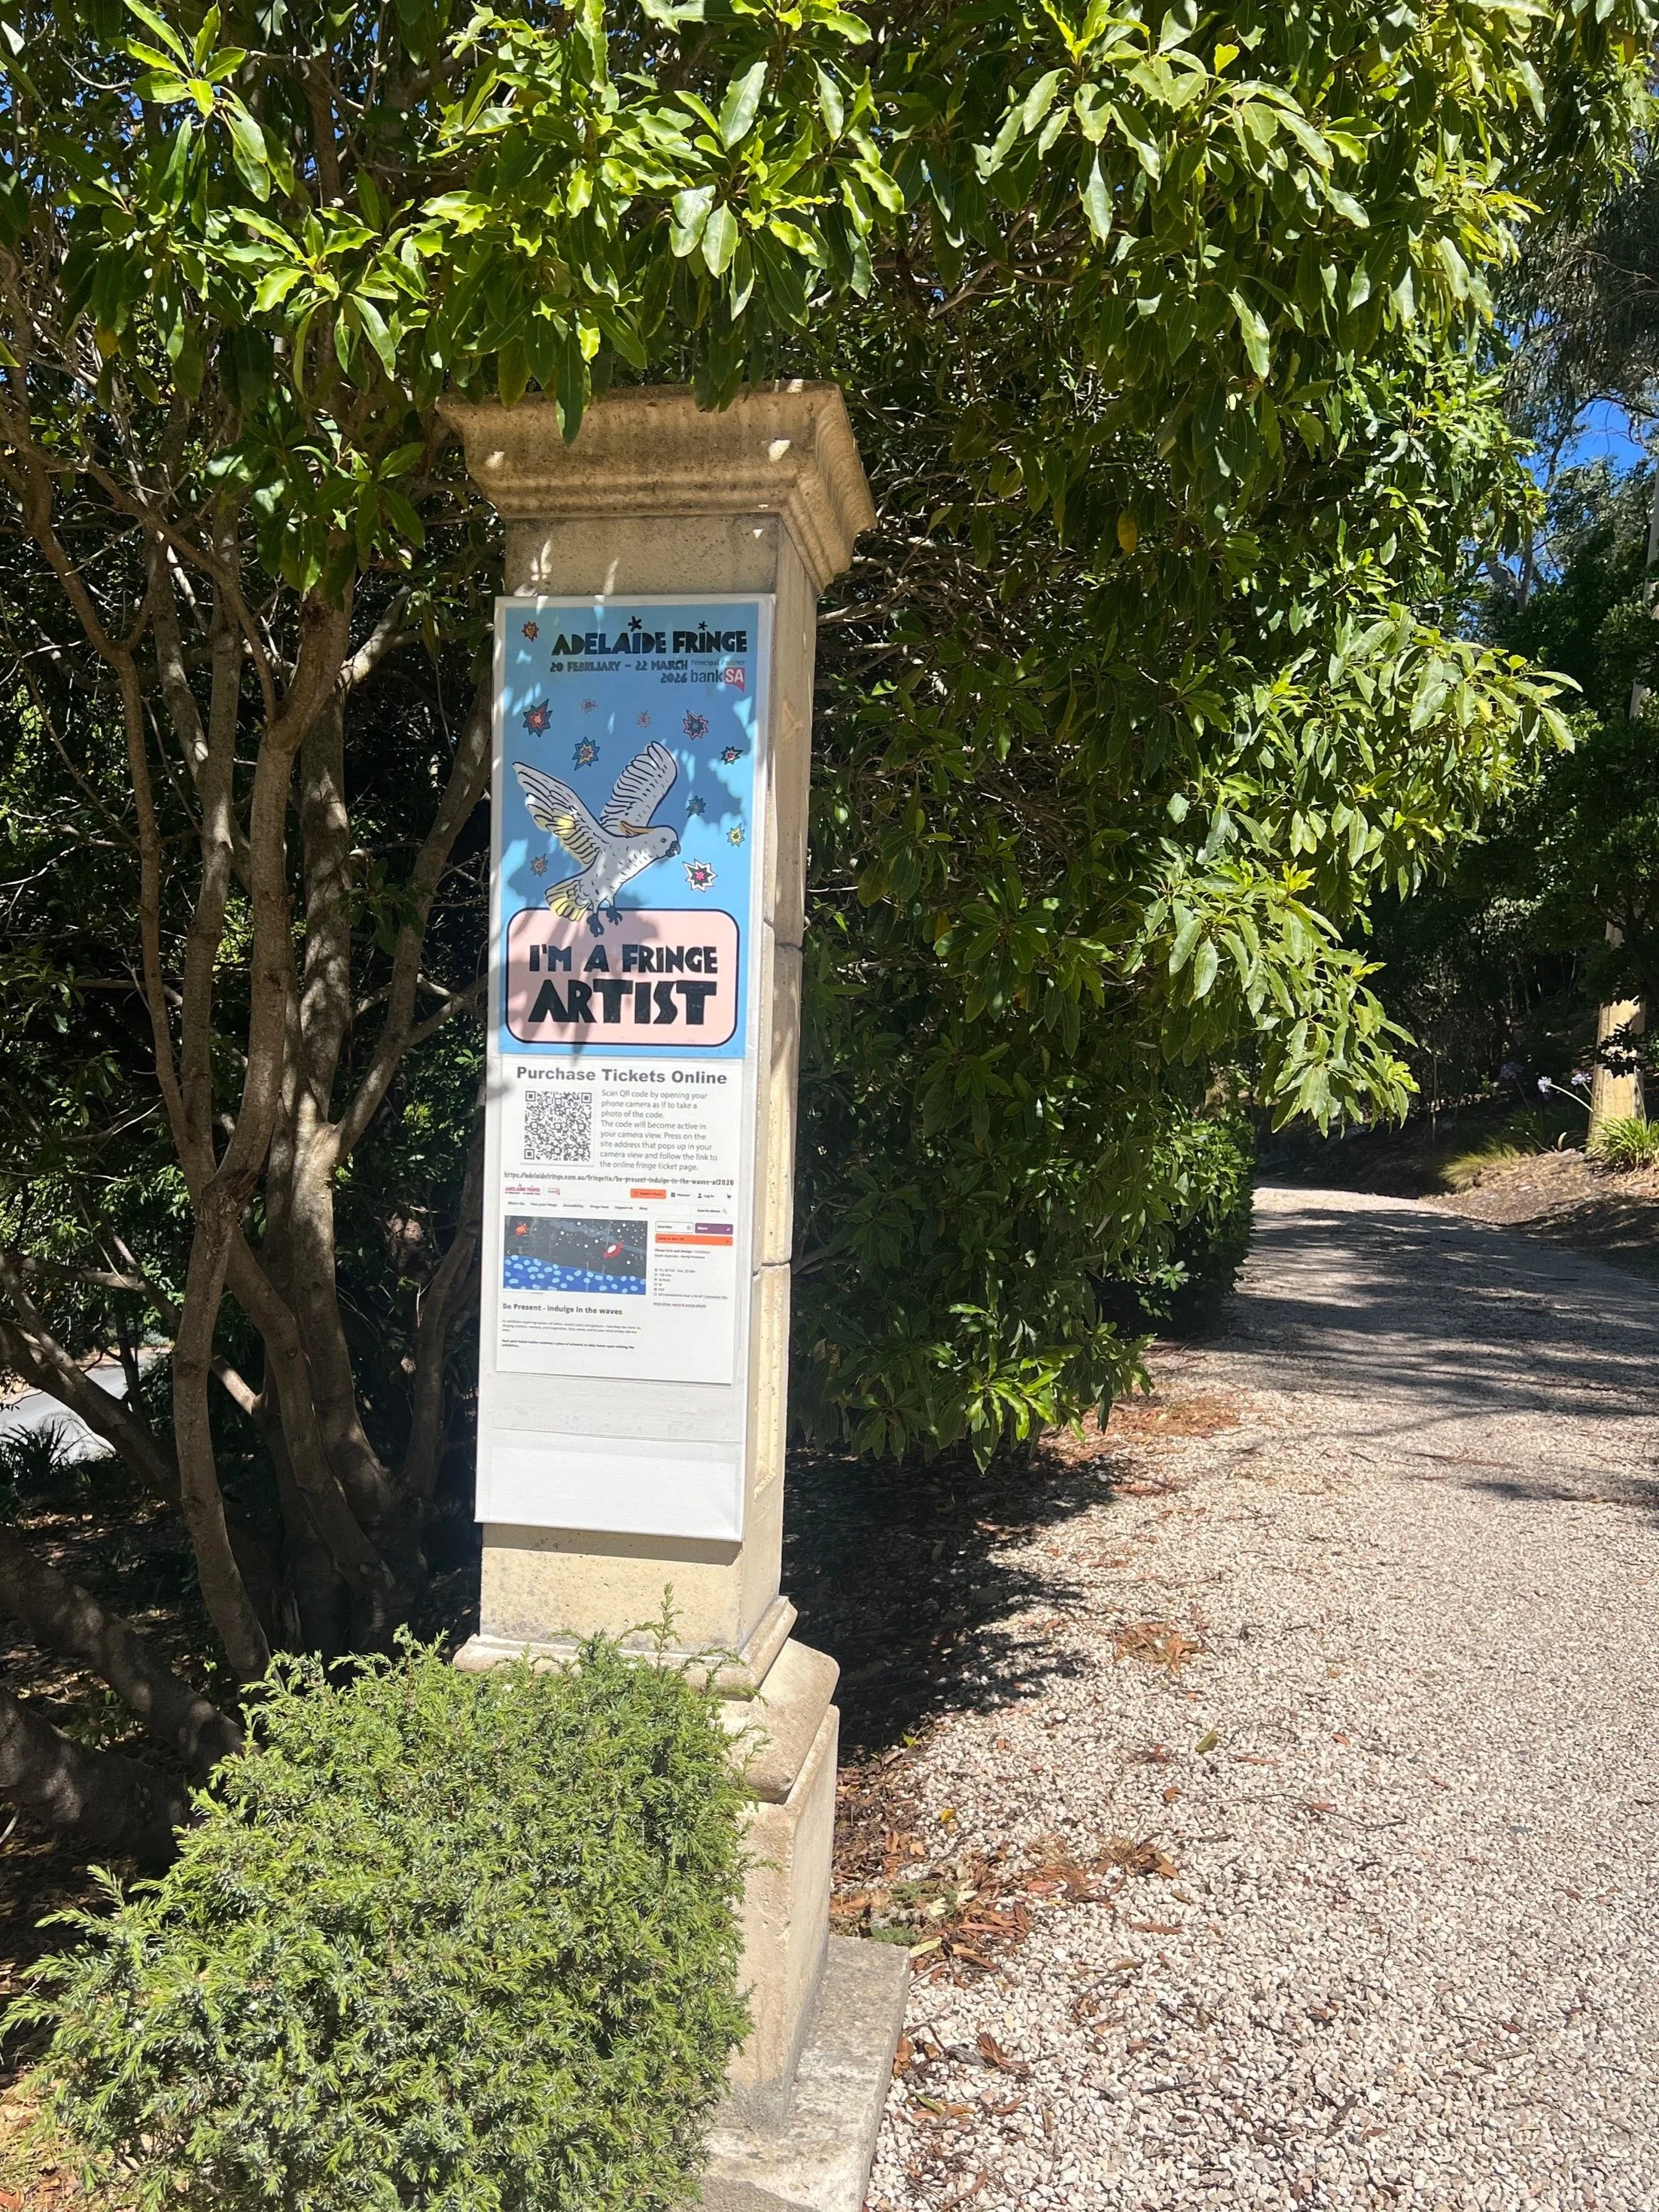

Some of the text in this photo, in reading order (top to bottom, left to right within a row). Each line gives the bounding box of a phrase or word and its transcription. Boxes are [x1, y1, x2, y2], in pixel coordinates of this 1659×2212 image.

[551, 630, 747, 657] ADELAIDE FRINGE
[549, 662, 563, 672] 20
[567, 661, 621, 672] FEBRUARY
[635, 660, 648, 672] 22
[651, 660, 688, 671] MARCH
[690, 659, 720, 667] Principal
[660, 672, 688, 684] 2026
[529, 943, 718, 973] I'M A FRINGE
[528, 979, 717, 1025] ARTIST
[516, 1066, 727, 1084] Purchase Tickets Online
[650, 1090, 659, 1099] by
[660, 1092, 689, 1100] opening
[601, 1110, 623, 1118] photo
[613, 1160, 635, 1168] online
[635, 1161, 656, 1170] fringe
[658, 1162, 677, 1170] ticket
[679, 1163, 699, 1172] page.
[513, 1303, 542, 1312] Present
[547, 1305, 574, 1314] indulge
